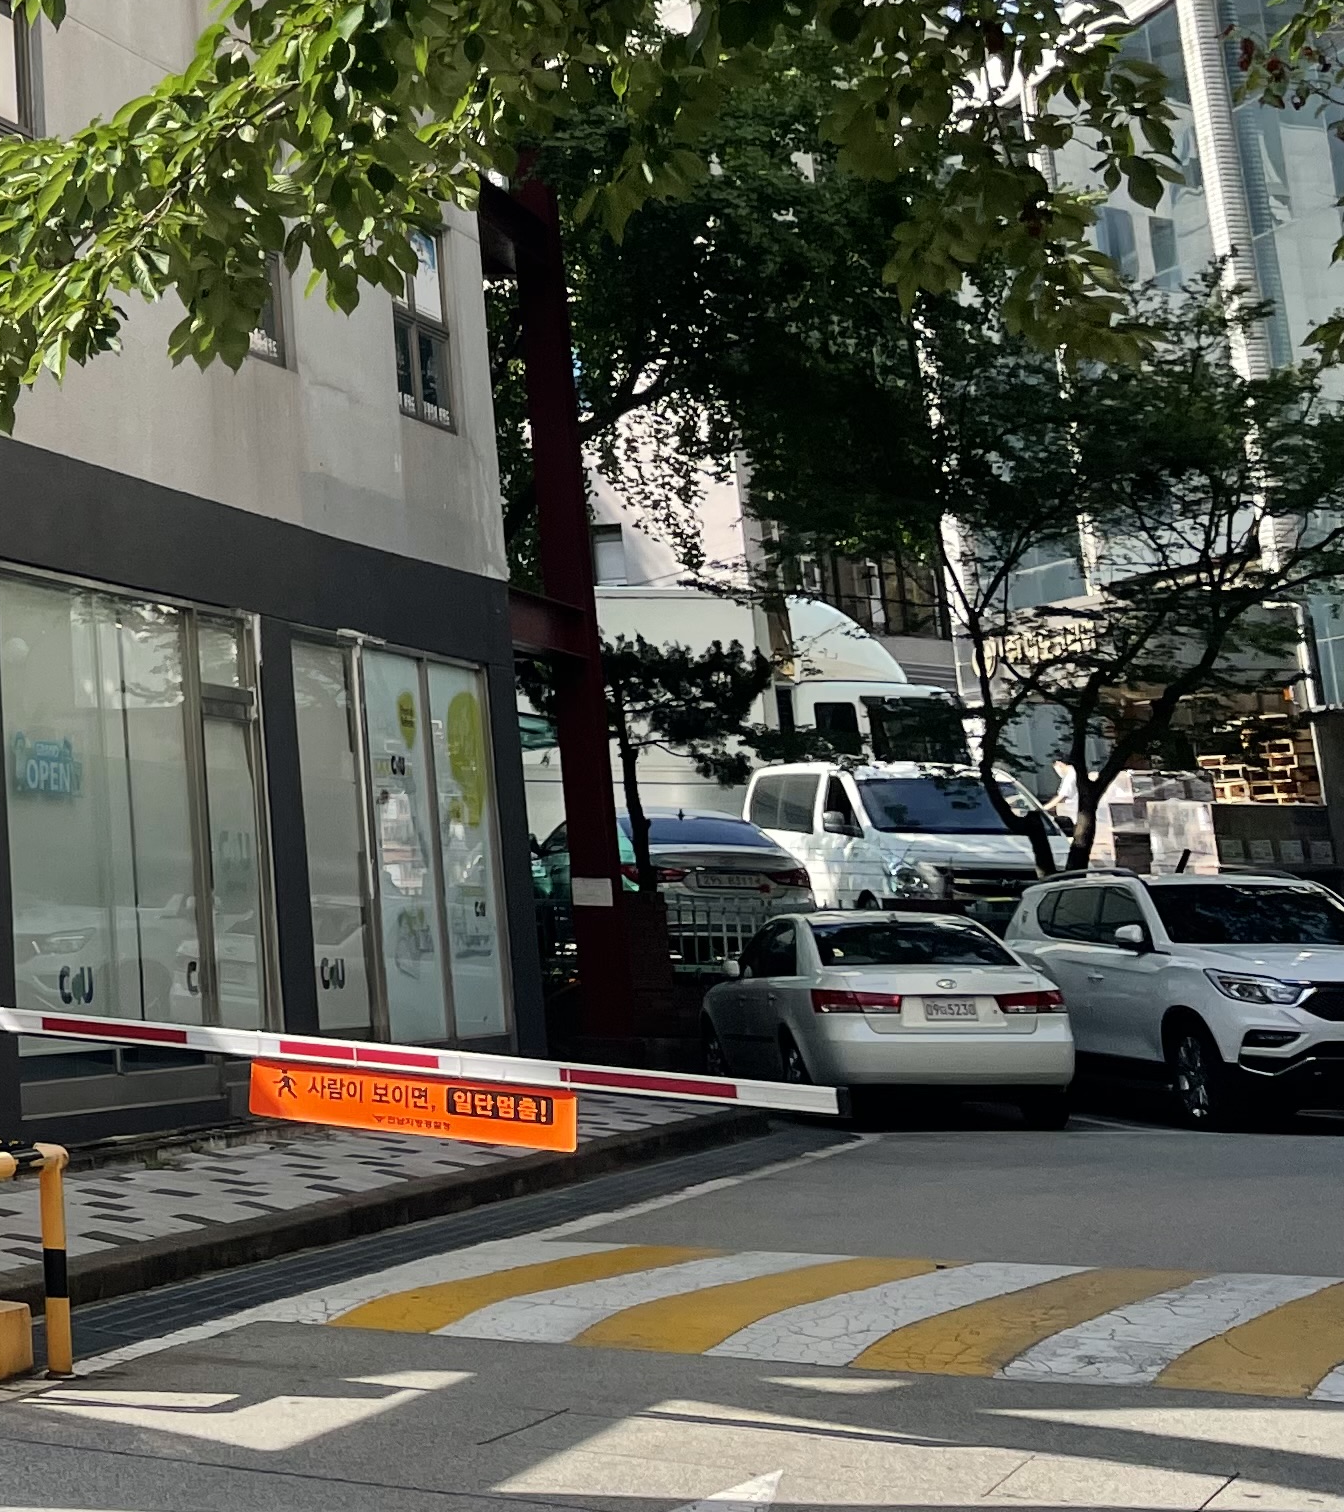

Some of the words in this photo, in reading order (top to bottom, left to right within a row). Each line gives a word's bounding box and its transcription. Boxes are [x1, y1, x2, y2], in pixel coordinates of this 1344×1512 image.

[26, 759, 71, 793] OPEN
[307, 1075, 364, 1104] 사람이
[372, 1083, 436, 1113] 보이면,
